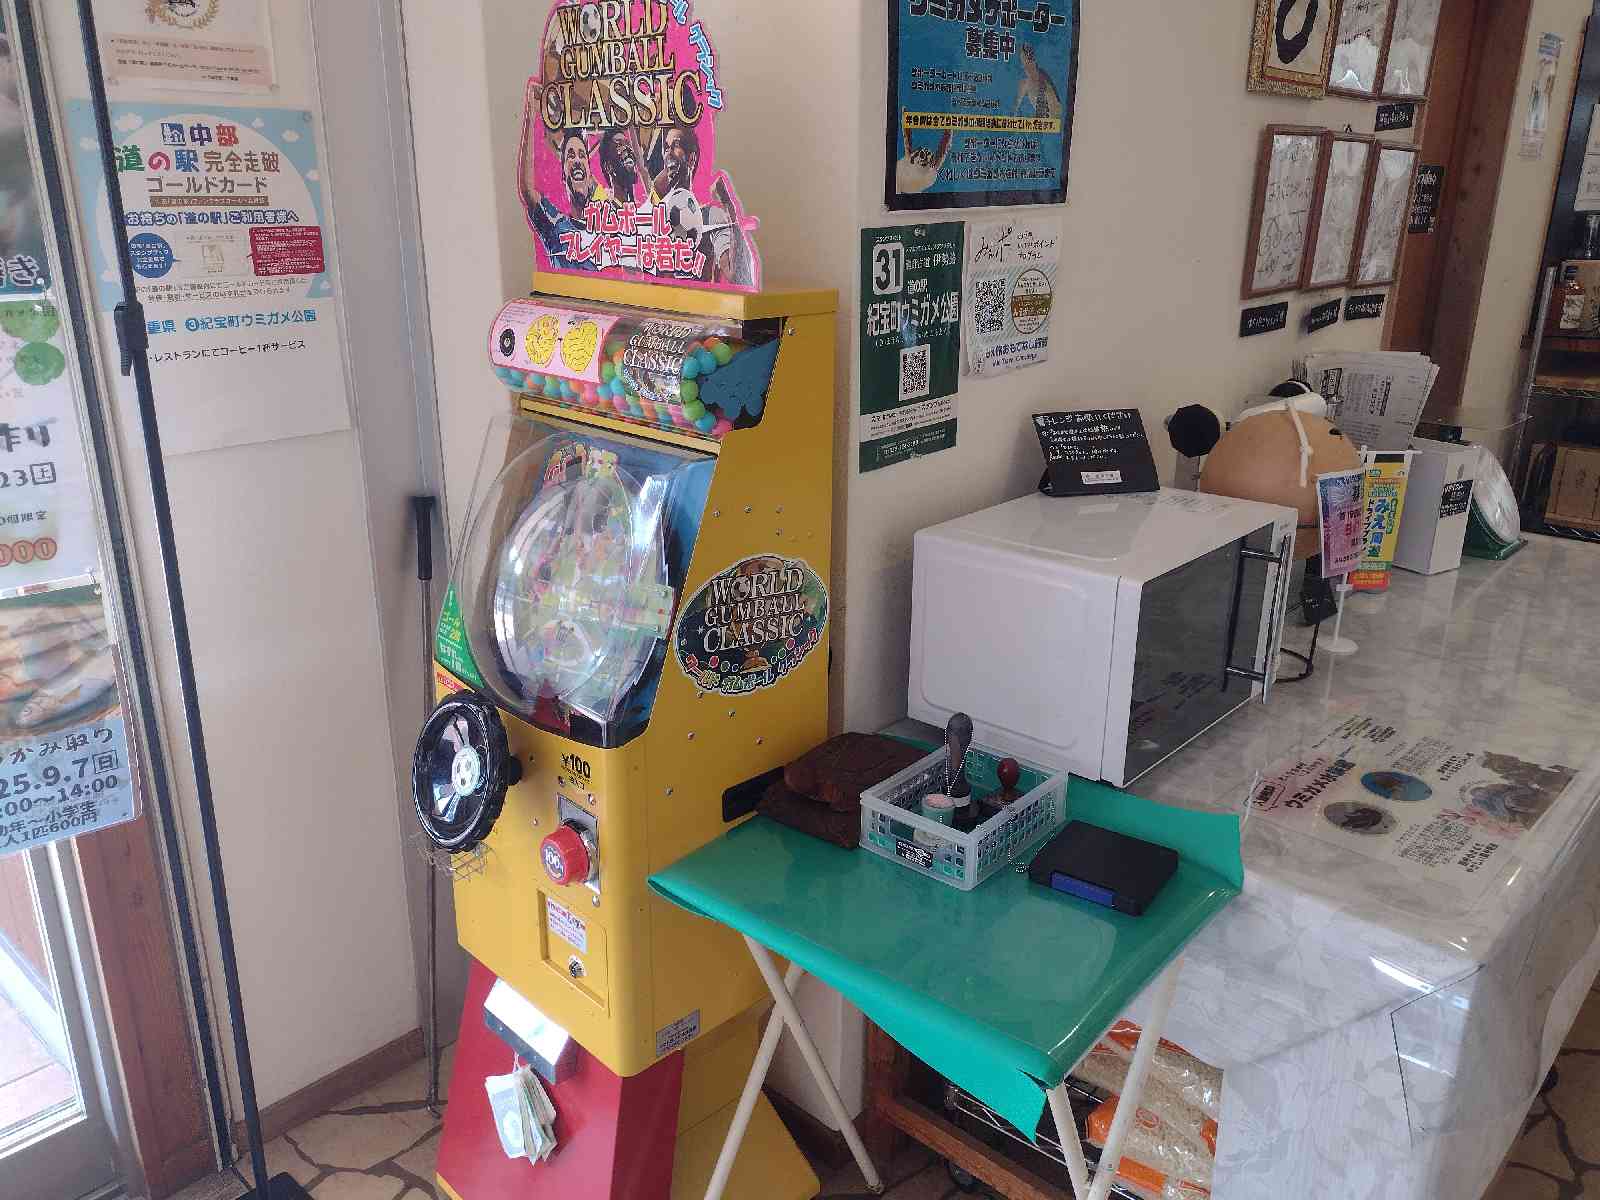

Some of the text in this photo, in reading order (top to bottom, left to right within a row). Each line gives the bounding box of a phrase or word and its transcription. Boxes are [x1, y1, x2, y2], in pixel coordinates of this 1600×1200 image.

[555, 0, 668, 46] WORLD
[560, 36, 674, 78] GUMBALL
[540, 71, 704, 129] CLASSIC
[146, 175, 269, 194] ゴールドカード
[583, 202, 673, 236] ガムボール
[147, 319, 177, 335] 重県
[866, 291, 960, 337] 紀宝町ウミガメ公園
[623, 348, 682, 374] CLASSIC
[707, 568, 803, 607] WORLD
[704, 594, 805, 627] GUMBALL
[704, 614, 804, 653] CLASSIC
[0, 727, 113, 764] かみ取り
